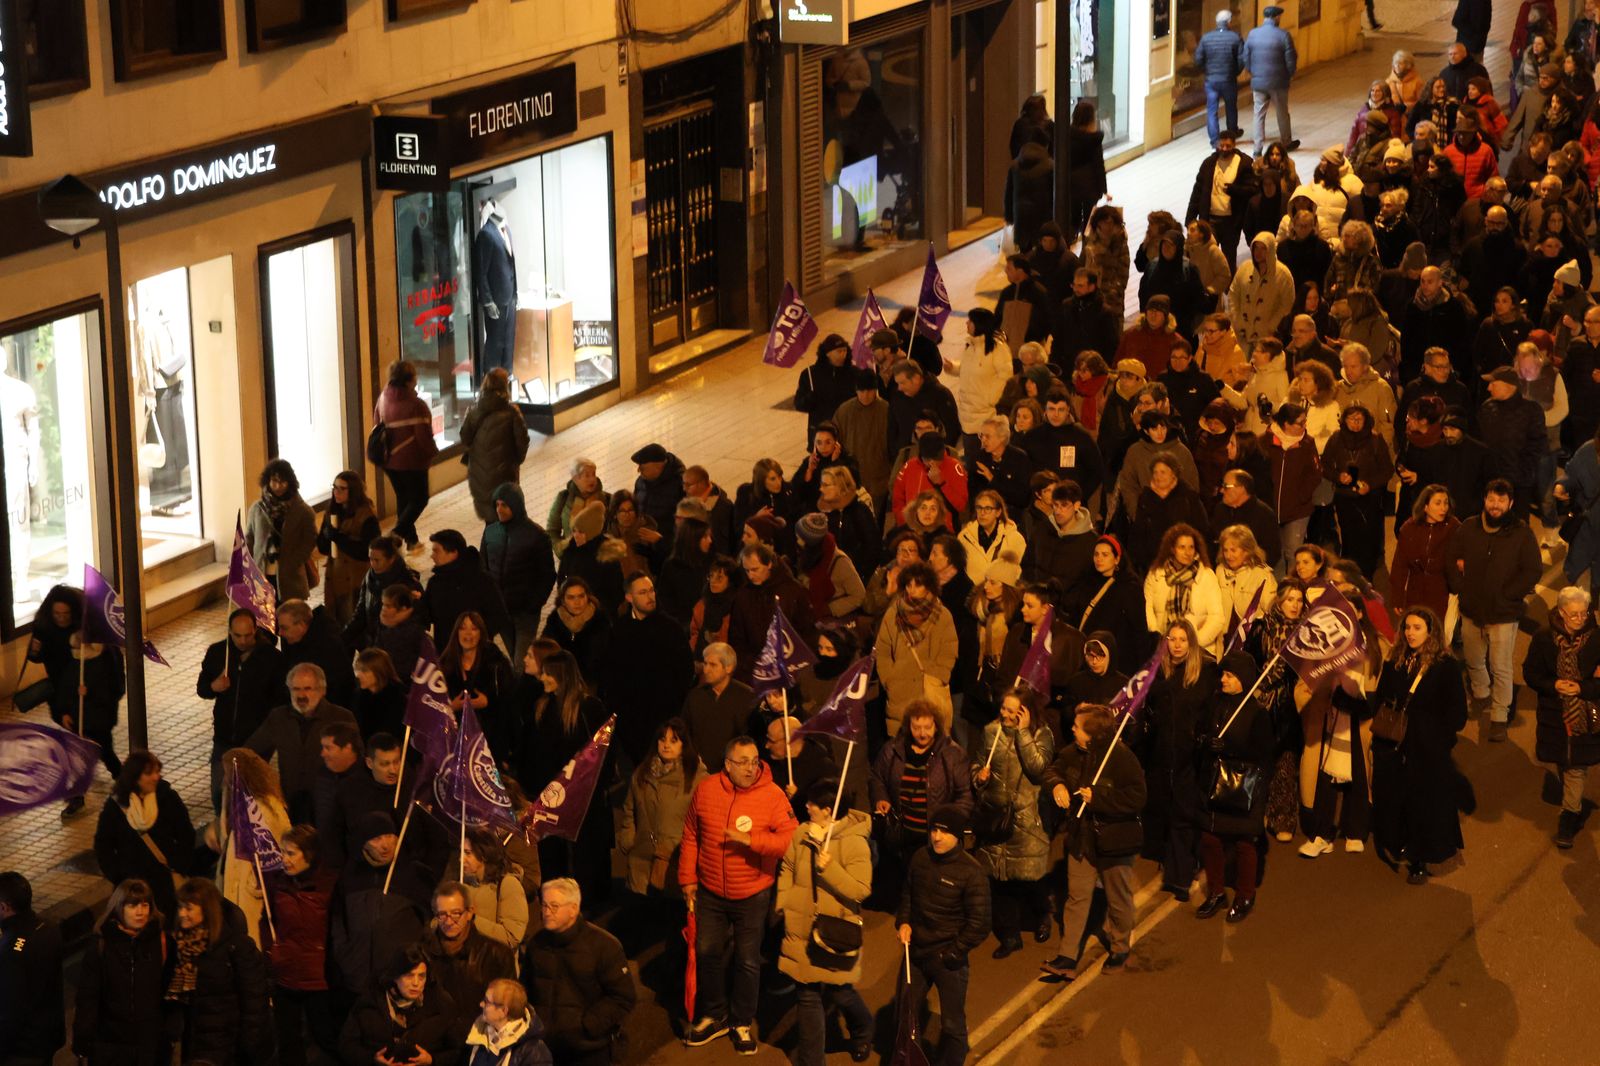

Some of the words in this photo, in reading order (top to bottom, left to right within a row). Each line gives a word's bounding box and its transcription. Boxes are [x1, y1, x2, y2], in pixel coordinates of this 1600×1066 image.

[469, 91, 553, 139] FLORENTINO
[173, 144, 276, 196] DOMINGUEZ
[380, 162, 437, 176] FLORENTINO
[30, 483, 84, 520] ORIGEN
[473, 764, 497, 800] Castilla
